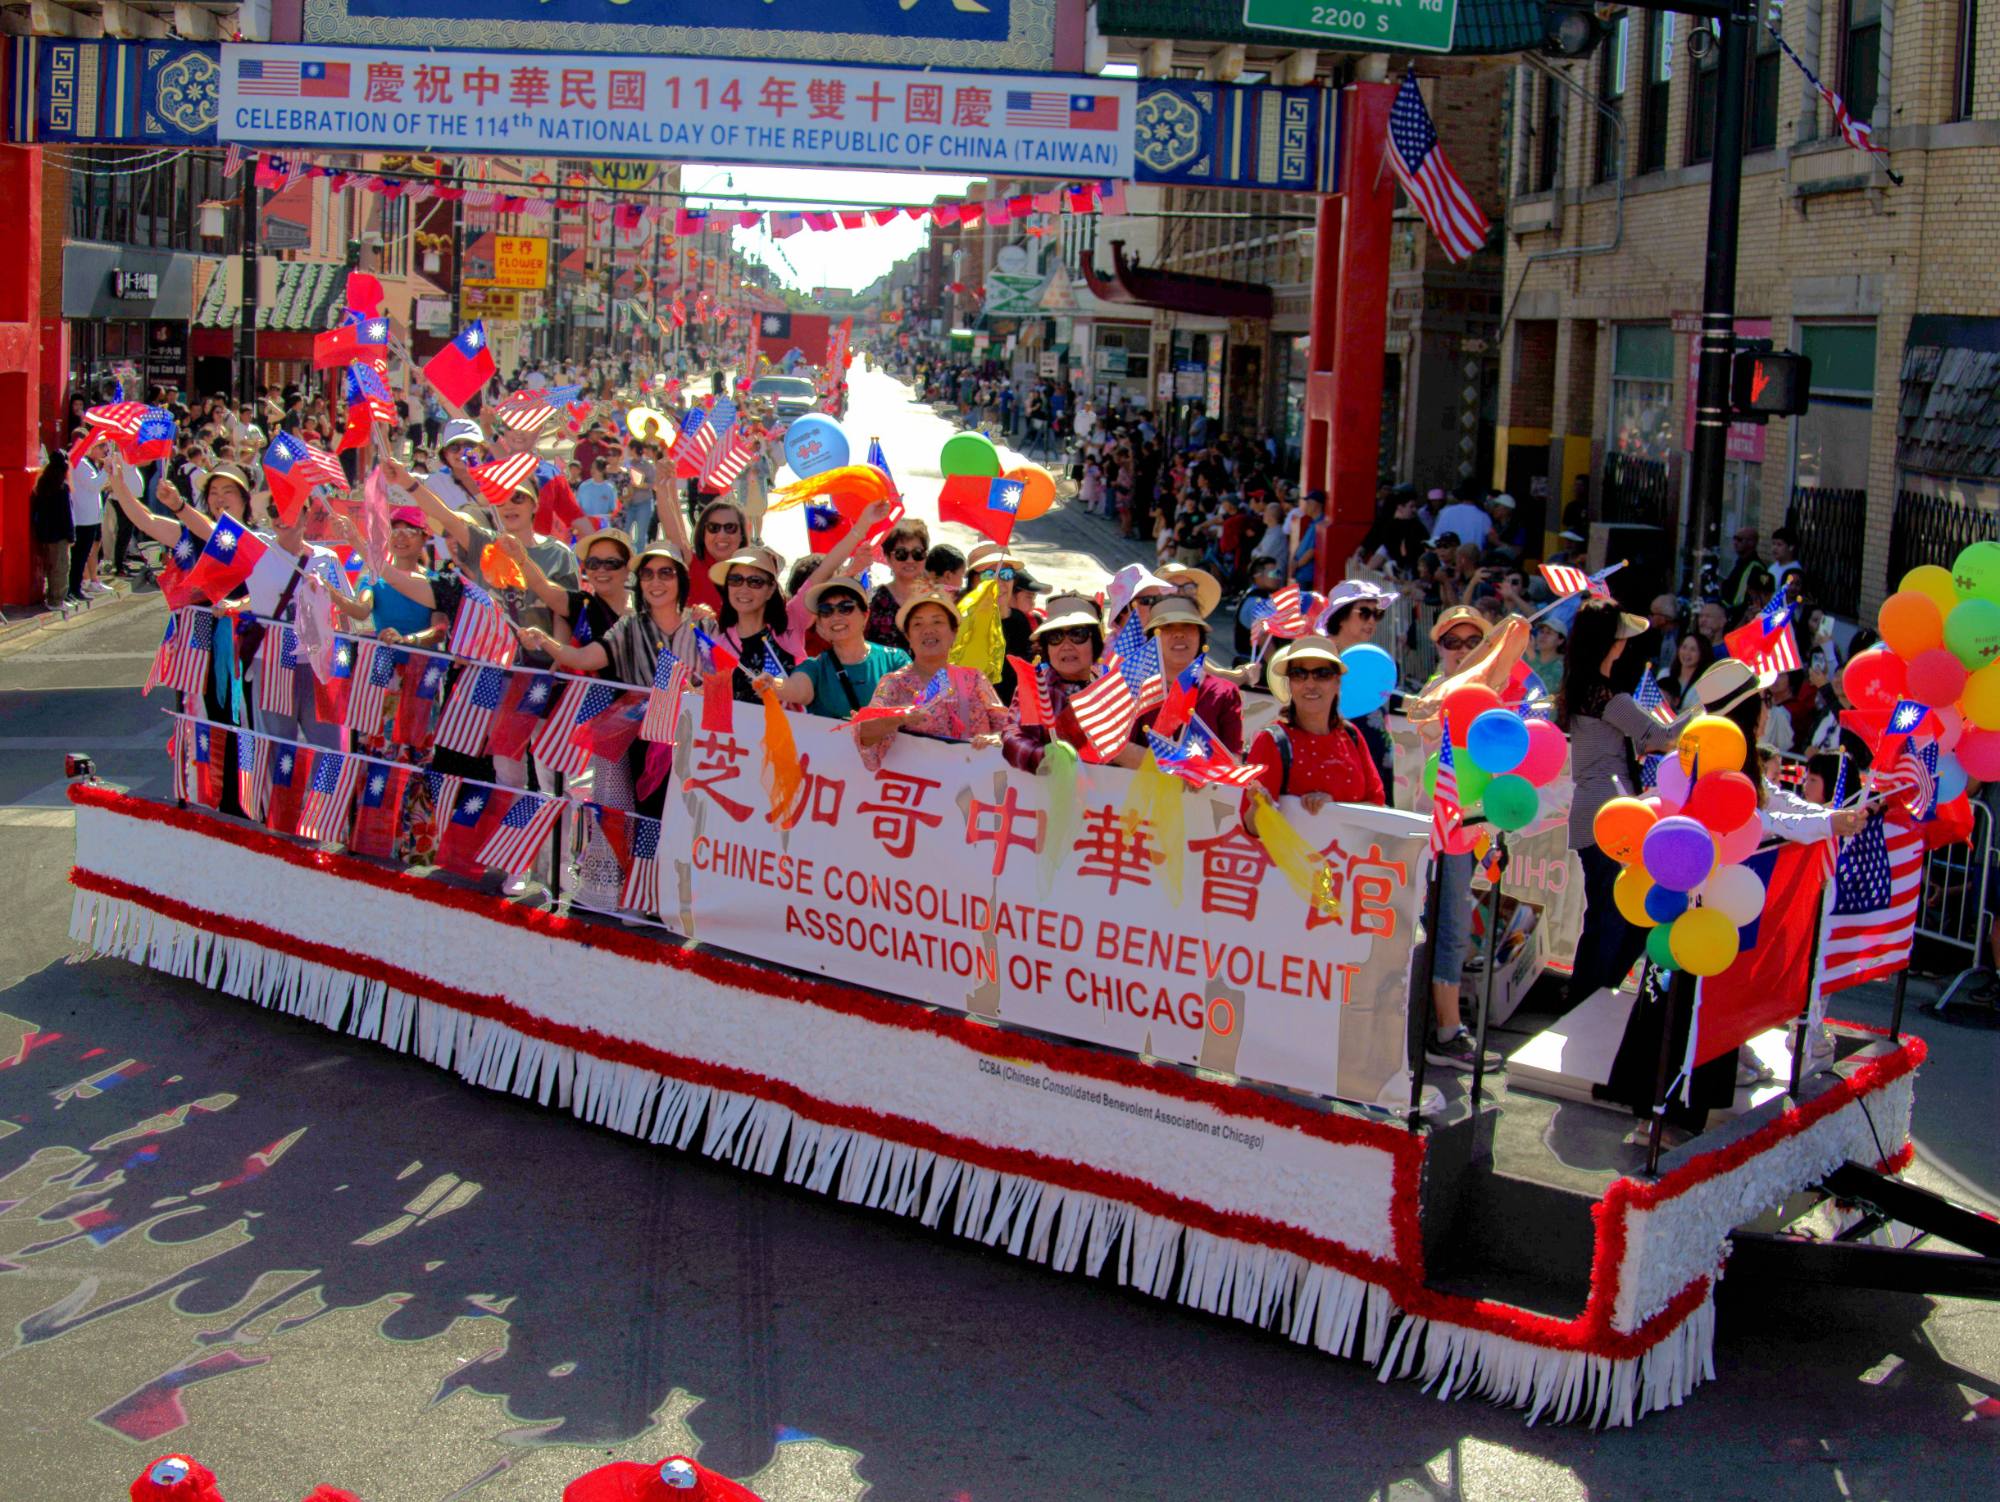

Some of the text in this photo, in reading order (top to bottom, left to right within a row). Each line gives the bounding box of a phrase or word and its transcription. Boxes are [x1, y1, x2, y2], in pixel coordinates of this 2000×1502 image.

[1311, 7, 1389, 32] 2200 S
[236, 107, 1118, 166] CELEBRATION OF THE 114th NATIONAL DAY OF THE REPUBLIC OF CHINA (TAIWAN)
[602, 161, 648, 181] KOW
[499, 257, 544, 269] FLOWER
[683, 733, 1406, 938] 芝加哥中華會館
[692, 836, 1361, 1005] CHINESE CONSOLIDATED BENEVOLENT
[785, 904, 1235, 1037] ASSOCIATION OF CHICAGO
[978, 1058, 1265, 1151] CCBA (Chinese Consolidated Benevolent Association at Chicago)
